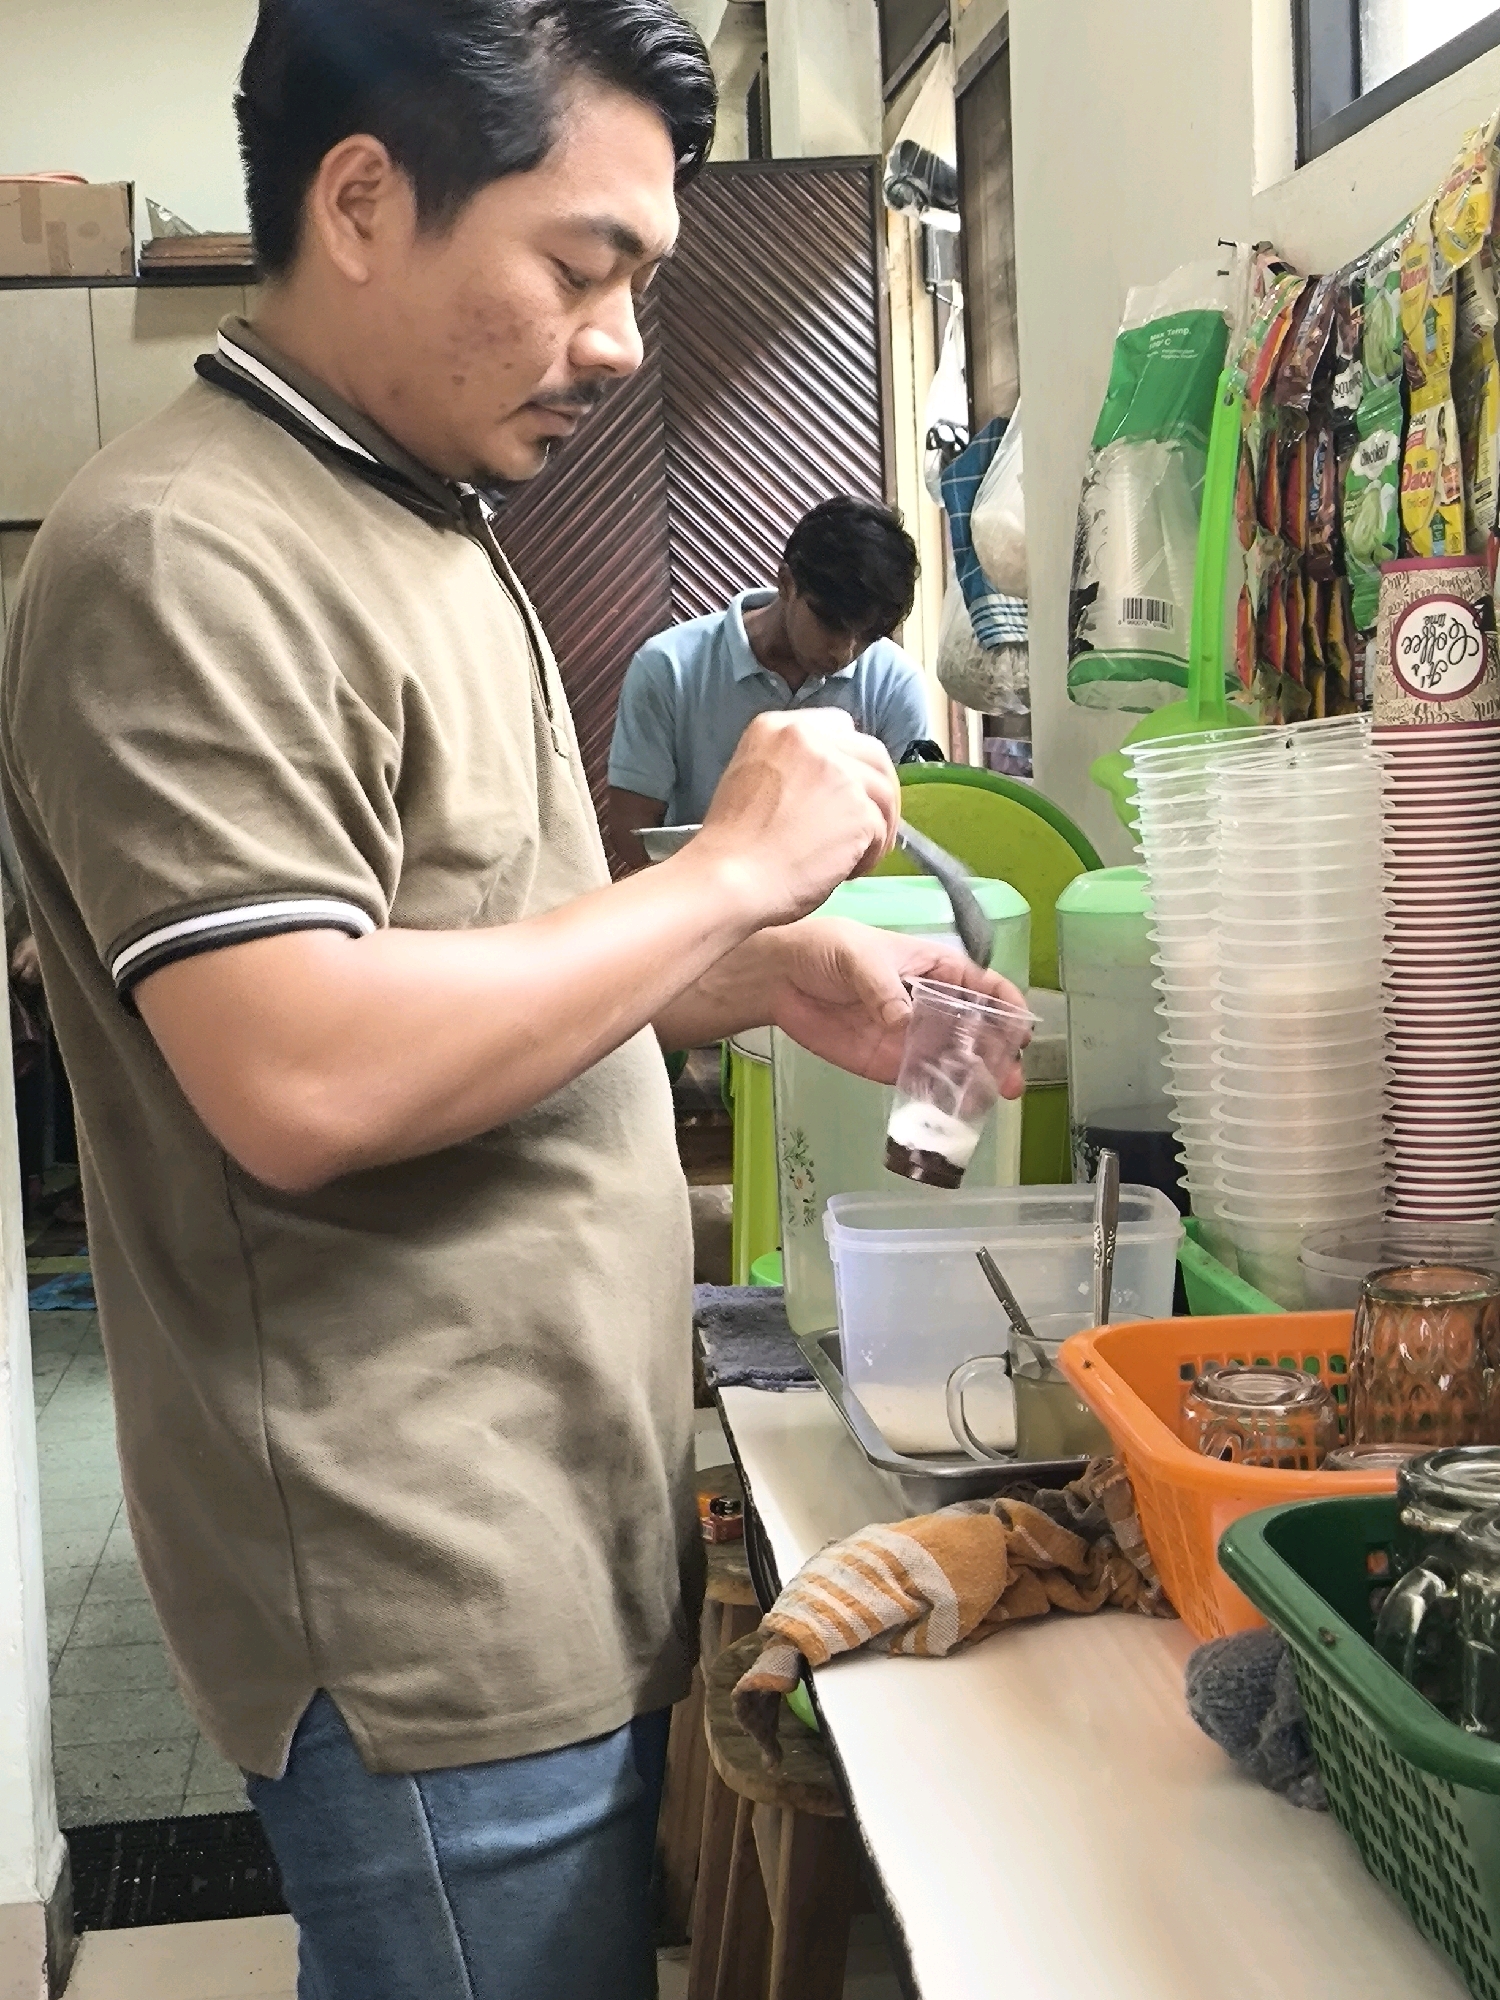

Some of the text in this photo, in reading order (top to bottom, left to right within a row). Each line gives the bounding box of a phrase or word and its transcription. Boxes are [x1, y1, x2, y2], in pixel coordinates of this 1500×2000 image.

[1424, 612, 1447, 627] time
[1401, 617, 1480, 665] Coffee
[1411, 659, 1449, 688] It's
